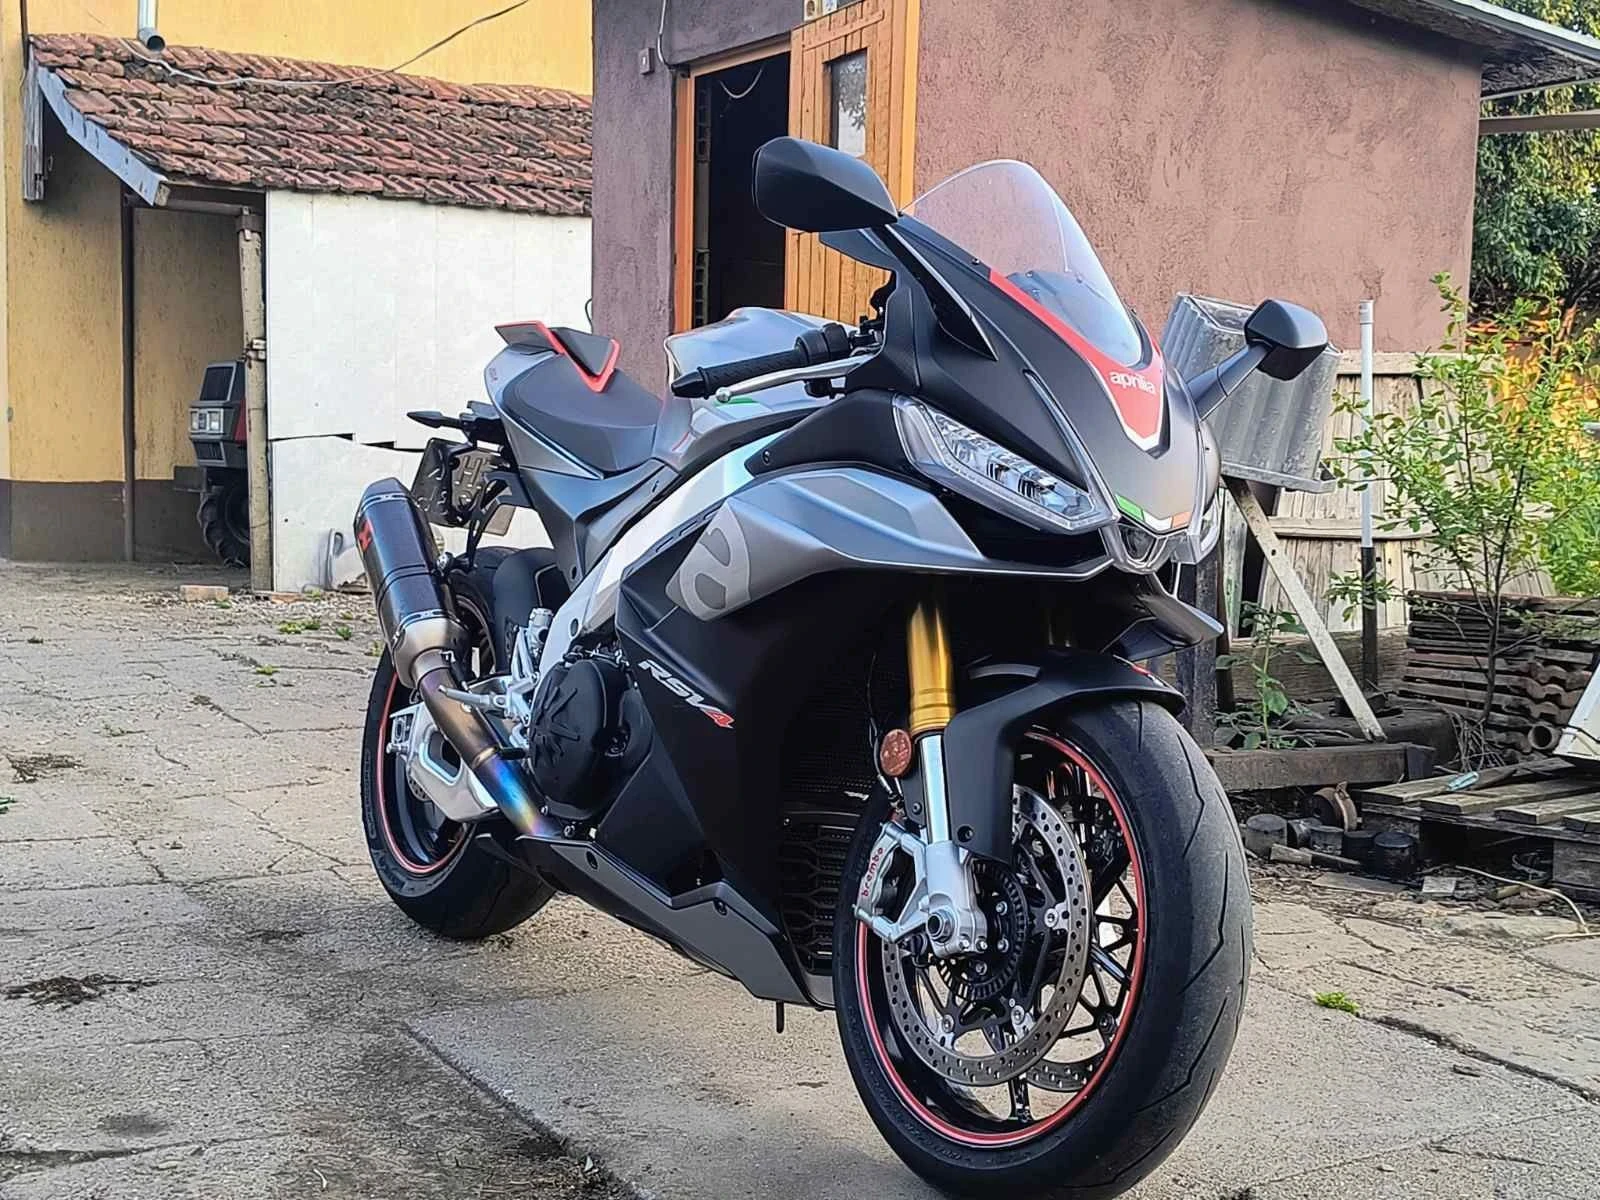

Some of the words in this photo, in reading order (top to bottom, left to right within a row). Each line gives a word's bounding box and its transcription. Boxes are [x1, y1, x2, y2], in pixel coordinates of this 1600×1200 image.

[1109, 371, 1156, 395] aprilia
[638, 659, 735, 729] RSV4
[861, 847, 884, 897] brembo
